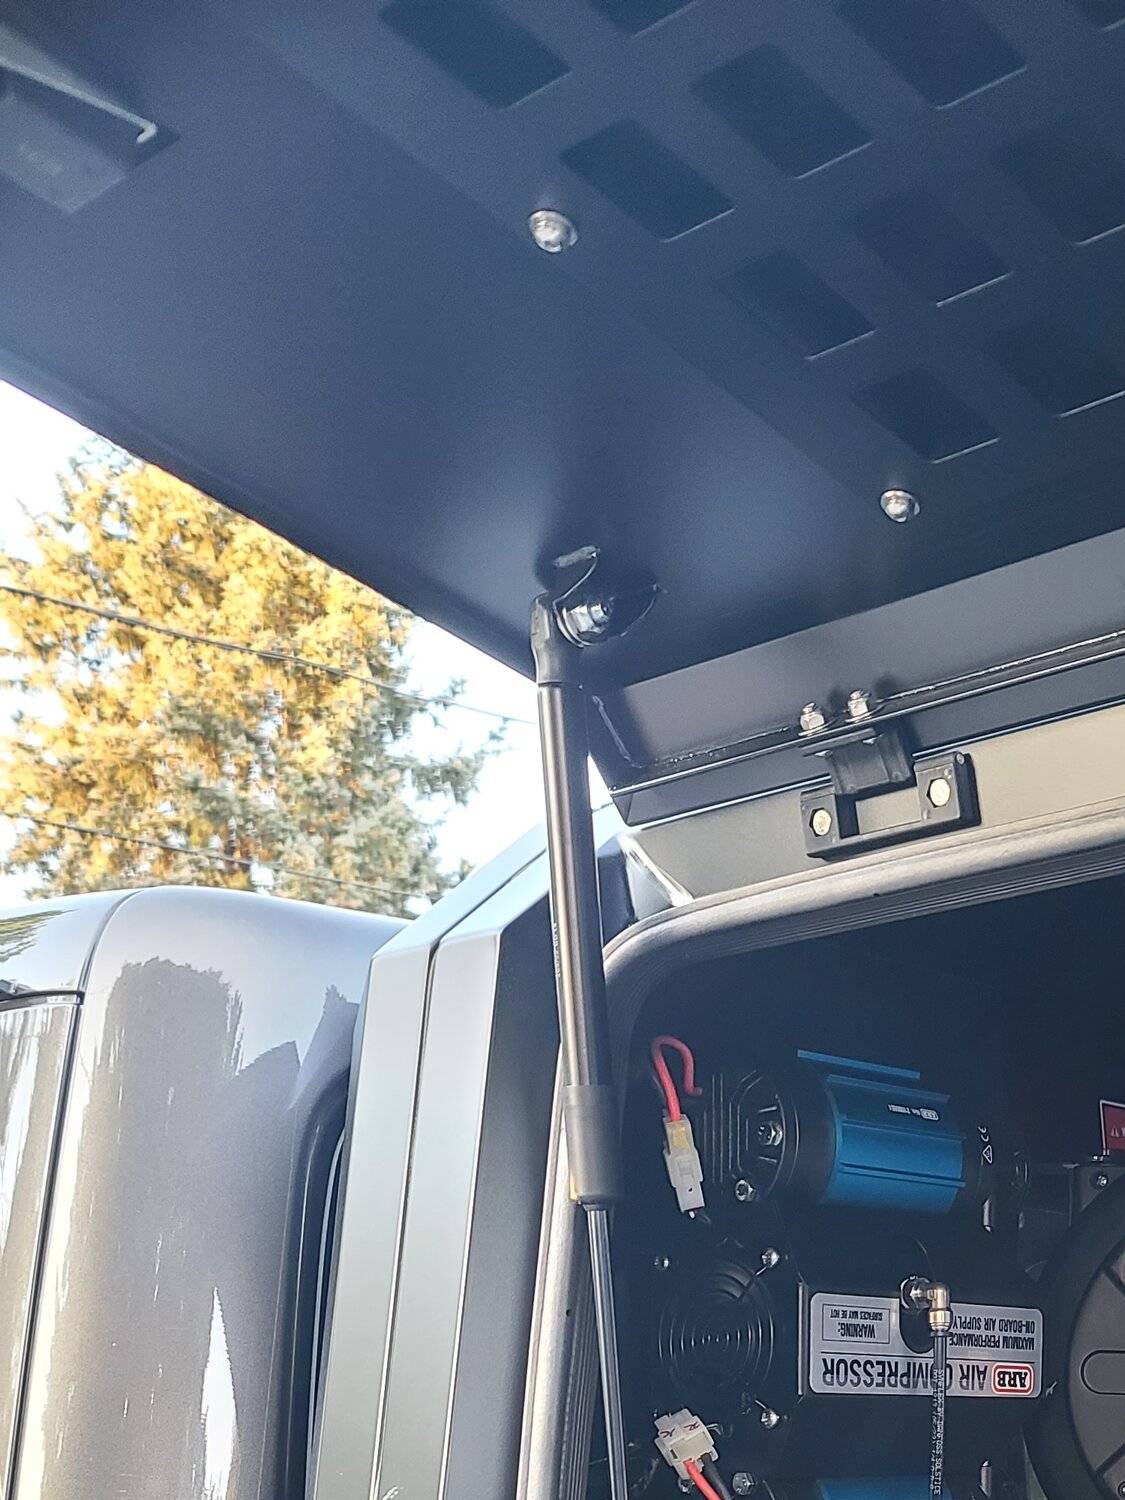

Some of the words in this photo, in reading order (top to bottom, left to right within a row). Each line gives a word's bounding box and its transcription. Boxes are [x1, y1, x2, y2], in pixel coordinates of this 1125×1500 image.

[830, 1309, 840, 1319] HOT
[840, 1309, 848, 1319] BE
[848, 1310, 859, 1320] MAY
[860, 1311, 883, 1321] SURFACES
[838, 1322, 876, 1339] WARNING:
[952, 1315, 982, 1331] SUPPLY
[984, 1317, 997, 1332] AIR
[998, 1319, 1035, 1334] ON-BOARD
[949, 1332, 1001, 1349] PERFORMANCE
[1002, 1336, 1035, 1351] MAXIMUM
[959, 1363, 988, 1391] AIR
[997, 1370, 1028, 1388] ARB
[933, 1457, 943, 1496] SOLSTICE
